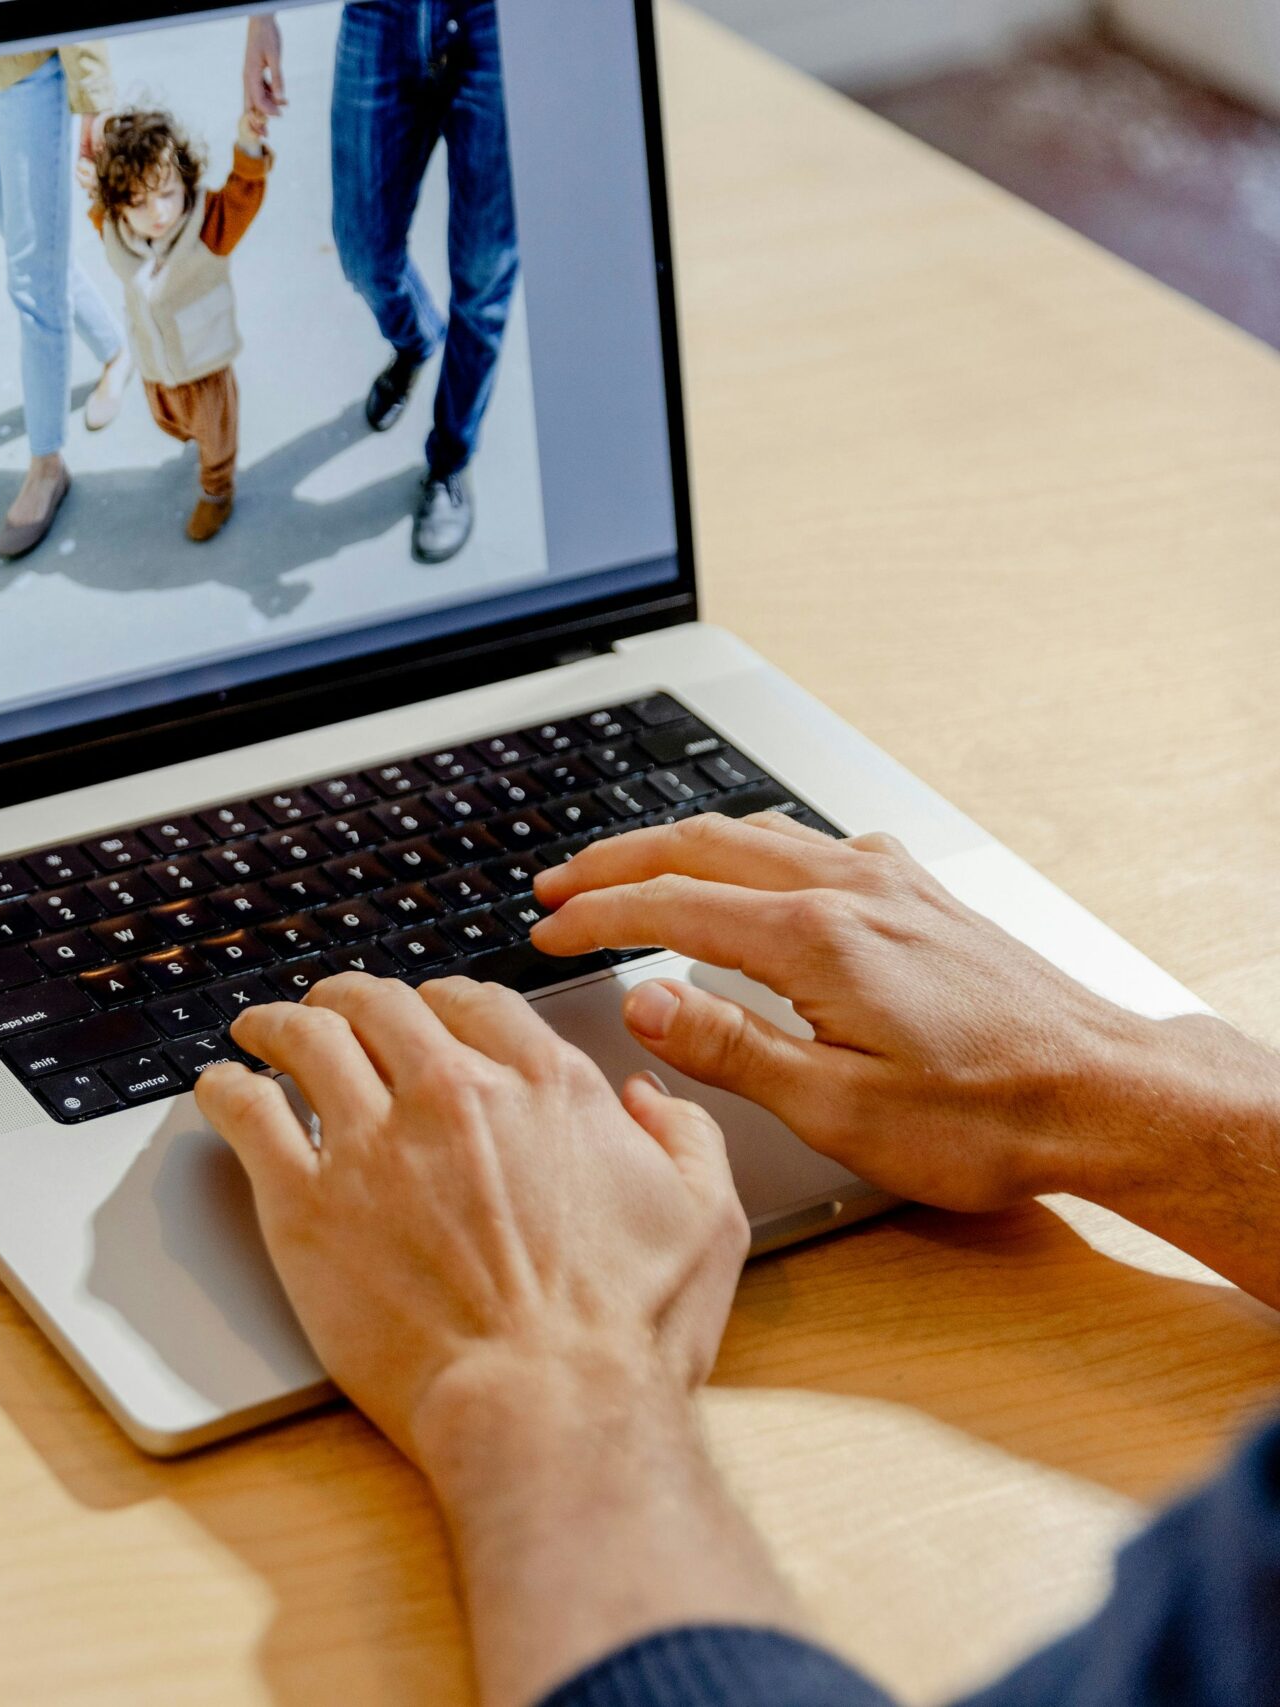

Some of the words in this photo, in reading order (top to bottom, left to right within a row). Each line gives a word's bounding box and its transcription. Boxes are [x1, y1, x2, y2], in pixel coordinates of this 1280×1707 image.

[513, 821, 531, 835] O
[404, 851, 422, 865] U
[348, 866, 363, 879] Y
[510, 866, 529, 880] K
[291, 881, 306, 894] T
[117, 892, 134, 904] 3
[234, 897, 252, 910] R
[398, 897, 417, 911] H
[59, 907, 76, 920] 2
[176, 913, 194, 926] E
[519, 908, 540, 924] M
[114, 928, 135, 942] W
[285, 929, 299, 942] F
[464, 924, 483, 938] N
[57, 946, 76, 958] Q
[226, 946, 243, 959] D
[408, 942, 426, 955] B
[167, 962, 184, 975] S
[349, 957, 365, 970] V
[109, 979, 125, 991] A
[292, 974, 309, 987] C
[232, 991, 251, 1004] X
[23, 1011, 48, 1025] lock
[172, 1007, 190, 1020] Z
[29, 1057, 58, 1070] shift
[75, 1074, 90, 1085] fn
[128, 1074, 169, 1092] control
